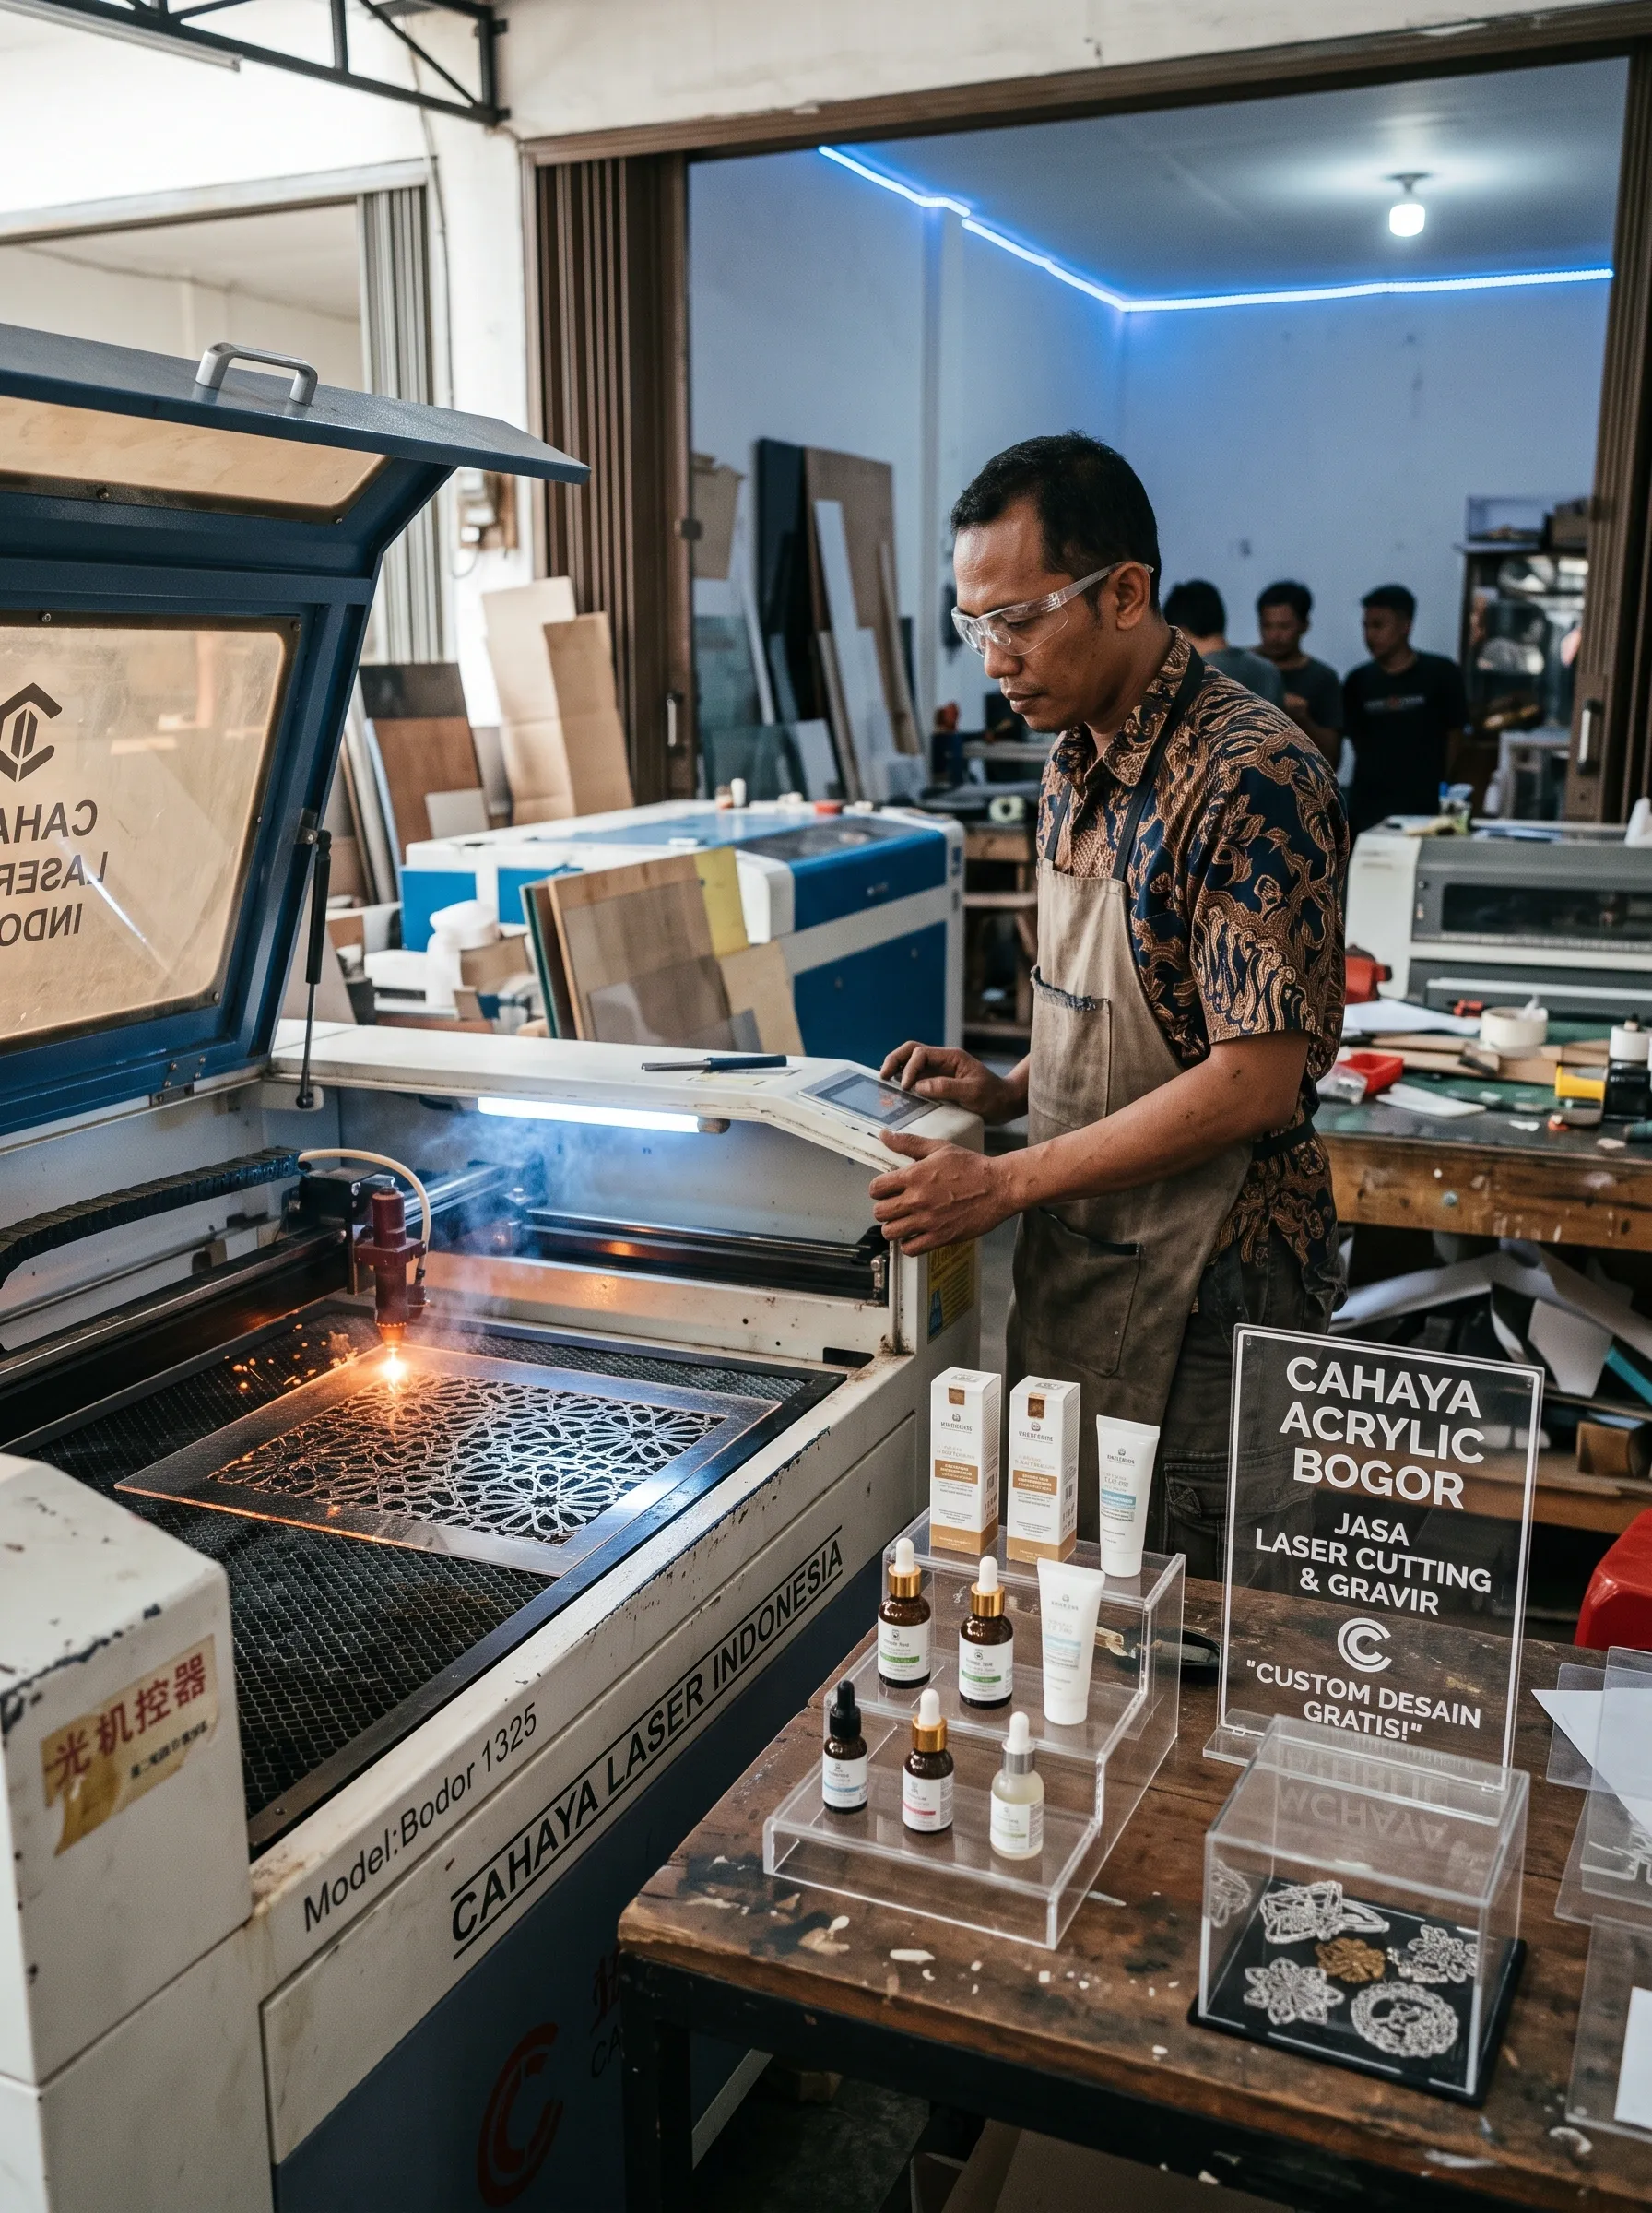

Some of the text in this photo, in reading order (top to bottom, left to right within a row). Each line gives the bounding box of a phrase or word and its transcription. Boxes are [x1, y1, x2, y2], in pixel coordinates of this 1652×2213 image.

[1286, 1356, 1481, 1418] CAHAYA
[1280, 1402, 1485, 1463] ACRYLIC
[1293, 1447, 1464, 1509] BOGOR
[1256, 1528, 1491, 1593] LASER CUTTING
[1334, 1513, 1409, 1546] JASA
[1299, 1568, 1438, 1615] & GRAVIR
[46, 1653, 206, 1788] 光机控器
[1246, 1660, 1481, 1728] "CUSTOM DESAIN
[1303, 1701, 1422, 1741] GRATIS!"
[452, 1539, 844, 1942] CAHAYA LASER INDONESIA
[481, 1701, 537, 1772] 1325
